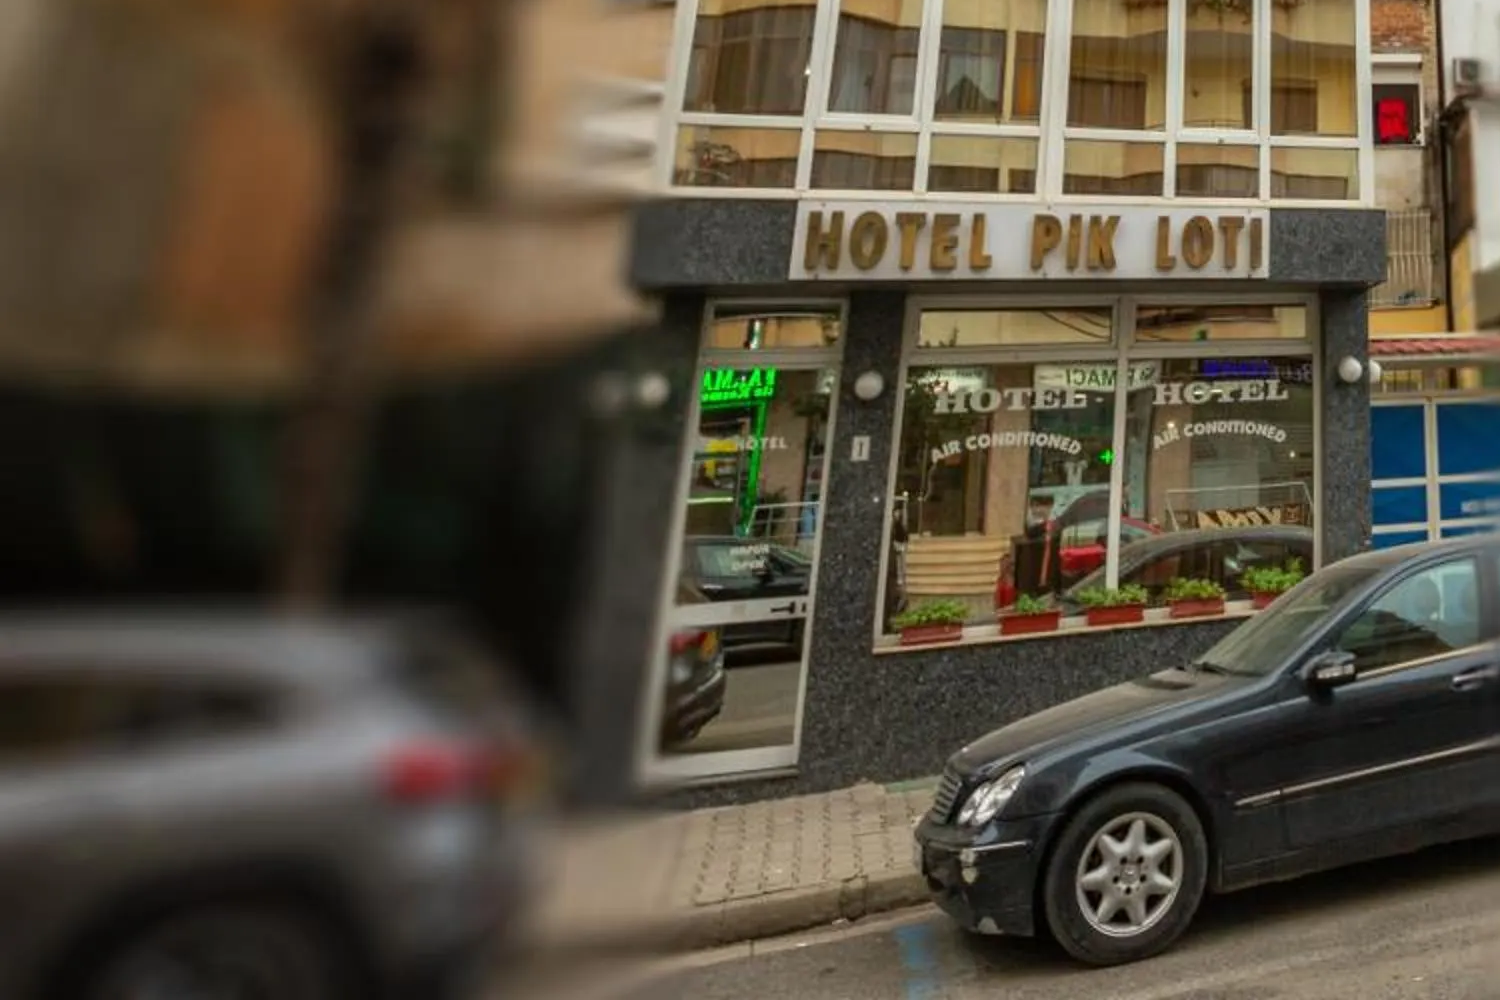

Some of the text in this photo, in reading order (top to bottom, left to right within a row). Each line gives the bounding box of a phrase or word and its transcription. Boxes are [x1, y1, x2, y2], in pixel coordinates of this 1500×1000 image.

[803, 209, 1264, 273] HOTEL PIK LOTI
[933, 386, 1087, 414] HOTEL
[1152, 379, 1289, 405] HOTEL
[736, 436, 788, 450] HOTEL
[930, 431, 1082, 463] AIR CONDITIONED
[1153, 420, 1288, 450] AIR CONDITIONED
